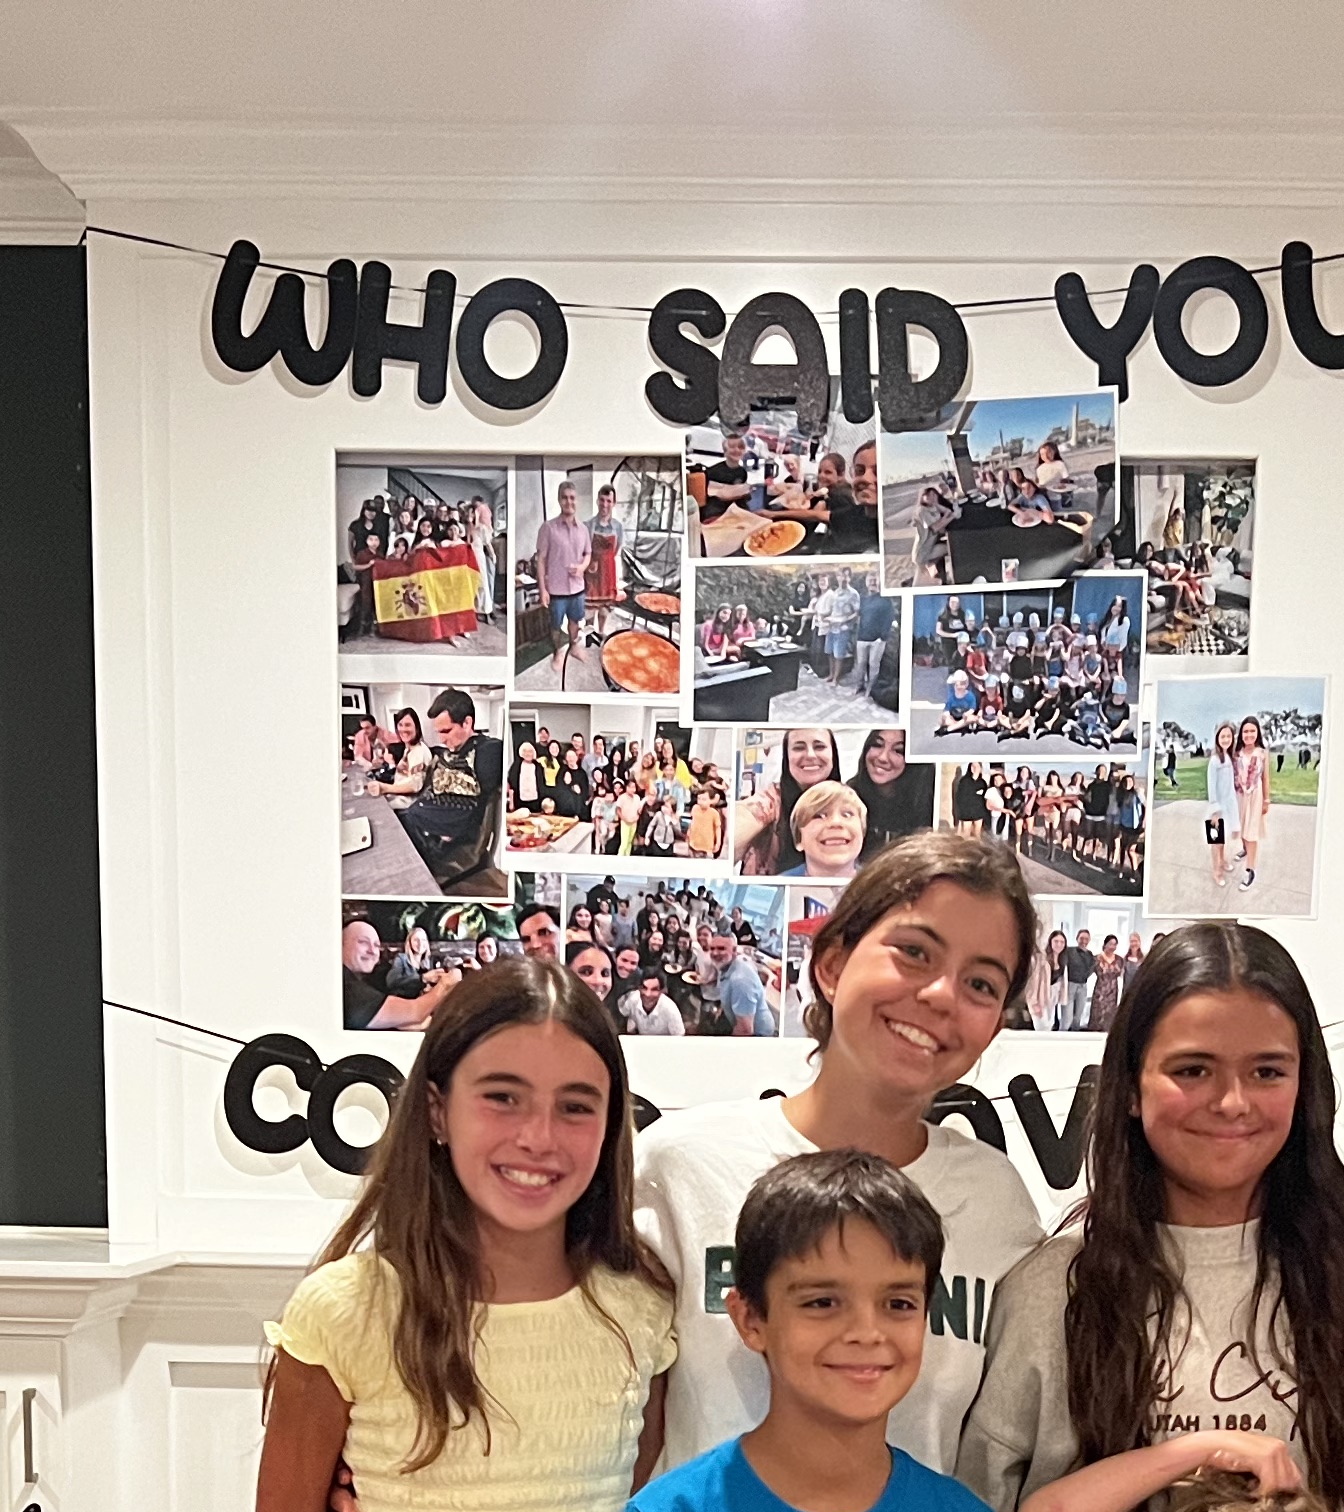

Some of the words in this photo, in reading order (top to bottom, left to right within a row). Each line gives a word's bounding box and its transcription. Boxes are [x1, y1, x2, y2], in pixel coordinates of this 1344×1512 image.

[210, 239, 569, 409] WHO
[643, 287, 972, 433] SAID
[1212, 1413, 1267, 1432] 1884
